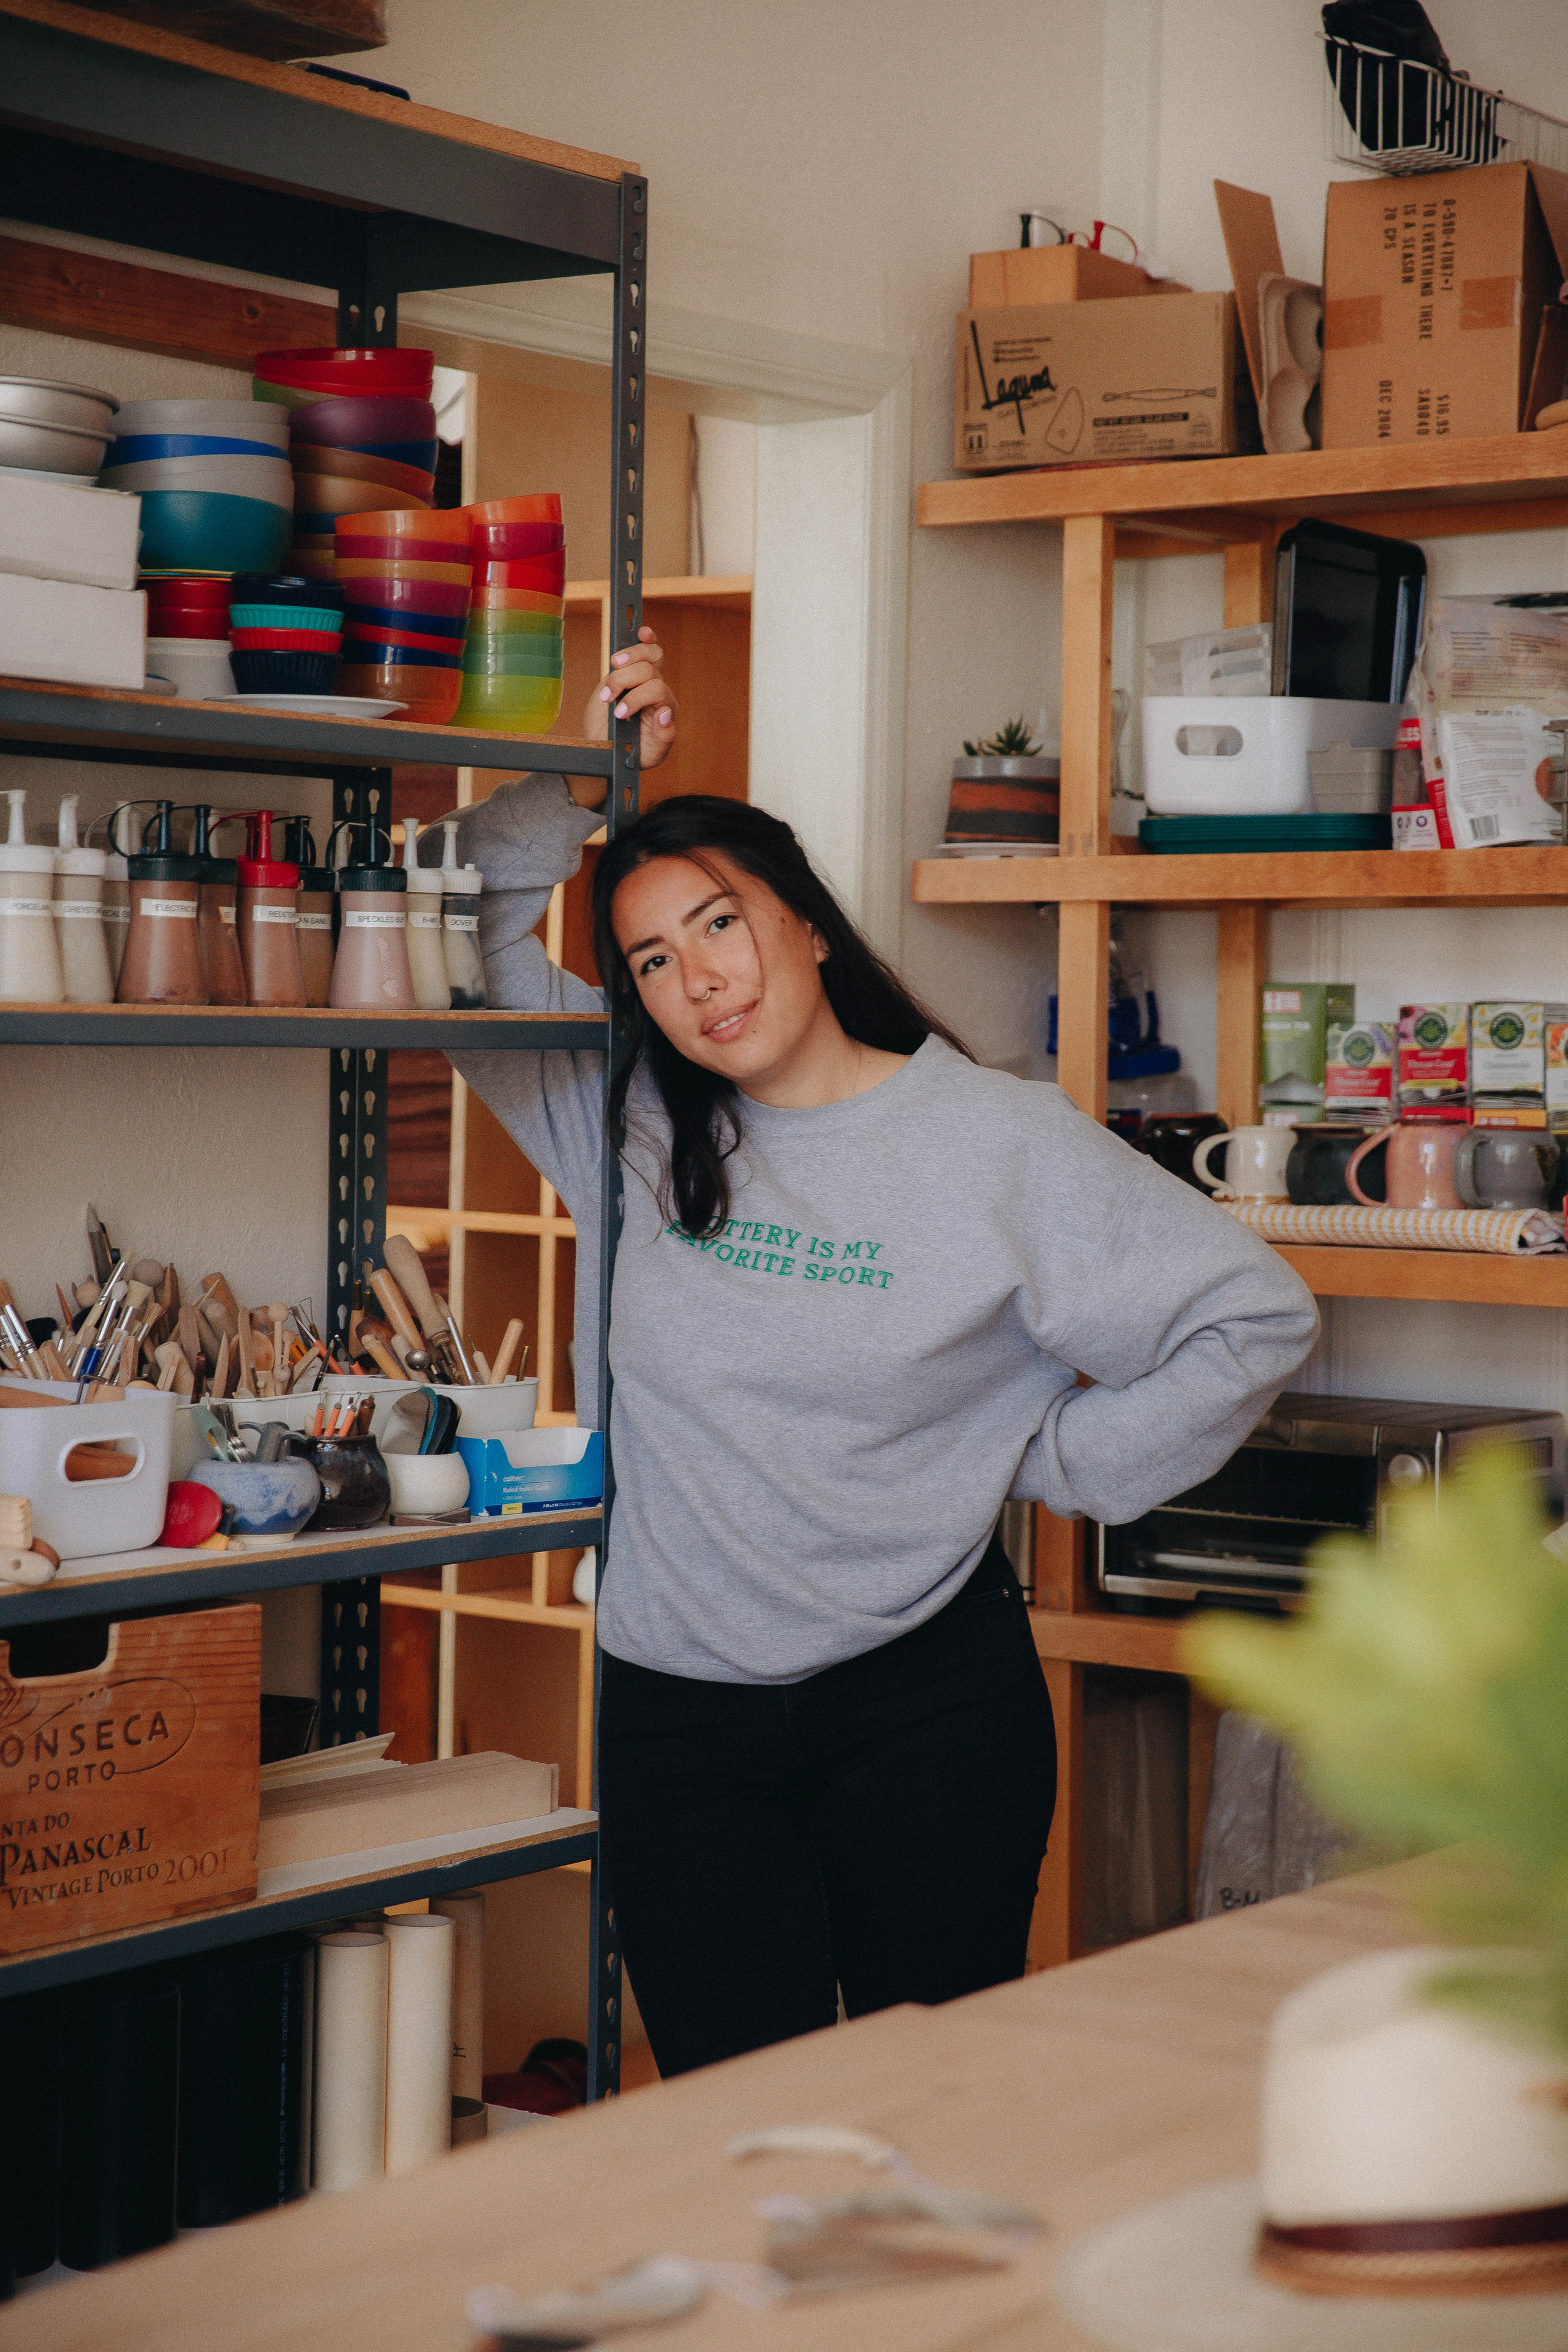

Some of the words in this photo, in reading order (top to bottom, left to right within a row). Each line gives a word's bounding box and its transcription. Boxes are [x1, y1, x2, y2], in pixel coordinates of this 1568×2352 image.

[1403, 204, 1416, 216] IS
[1401, 236, 1415, 284] SEASON
[1420, 222, 1436, 298] EVERYTHING
[1419, 305, 1433, 340] THERE
[706, 1215, 802, 1249] OTTERY
[807, 1236, 834, 1259] IS
[840, 1240, 884, 1261] MY
[802, 1262, 894, 1290] SPORT
[1, 1711, 169, 1767] ONSECA
[28, 1760, 116, 1793] PORTO
[2, 1820, 39, 1839] NTA
[44, 1812, 70, 1832] DO
[0, 1827, 152, 1887] PANASCAL
[164, 1848, 230, 1885] 2001
